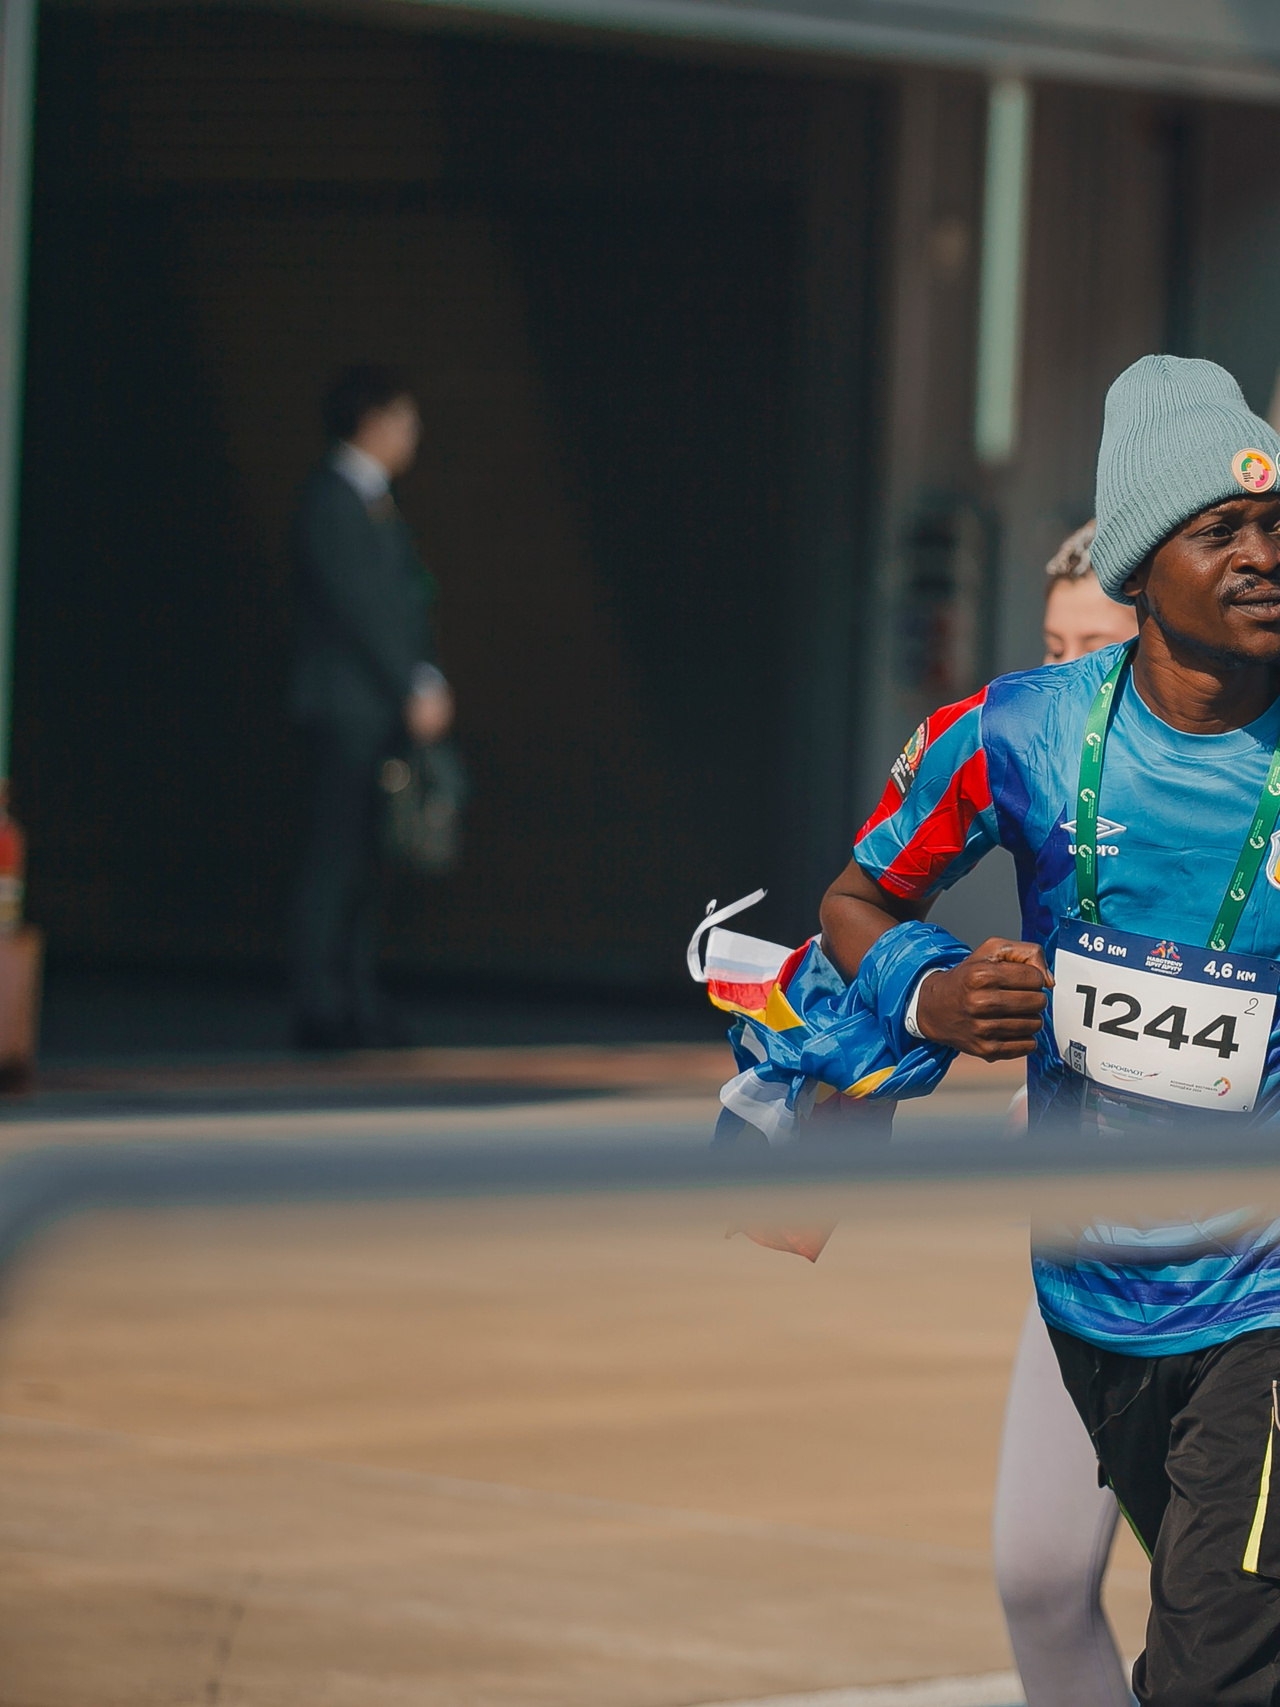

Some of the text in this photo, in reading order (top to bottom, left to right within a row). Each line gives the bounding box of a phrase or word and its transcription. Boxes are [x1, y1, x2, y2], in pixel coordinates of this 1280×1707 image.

[1068, 844, 1119, 857] uro
[1078, 932, 1105, 952] 4,6
[1203, 960, 1233, 979] 4,6
[1244, 997, 1259, 1016] 2
[1075, 984, 1239, 1060] 1244
